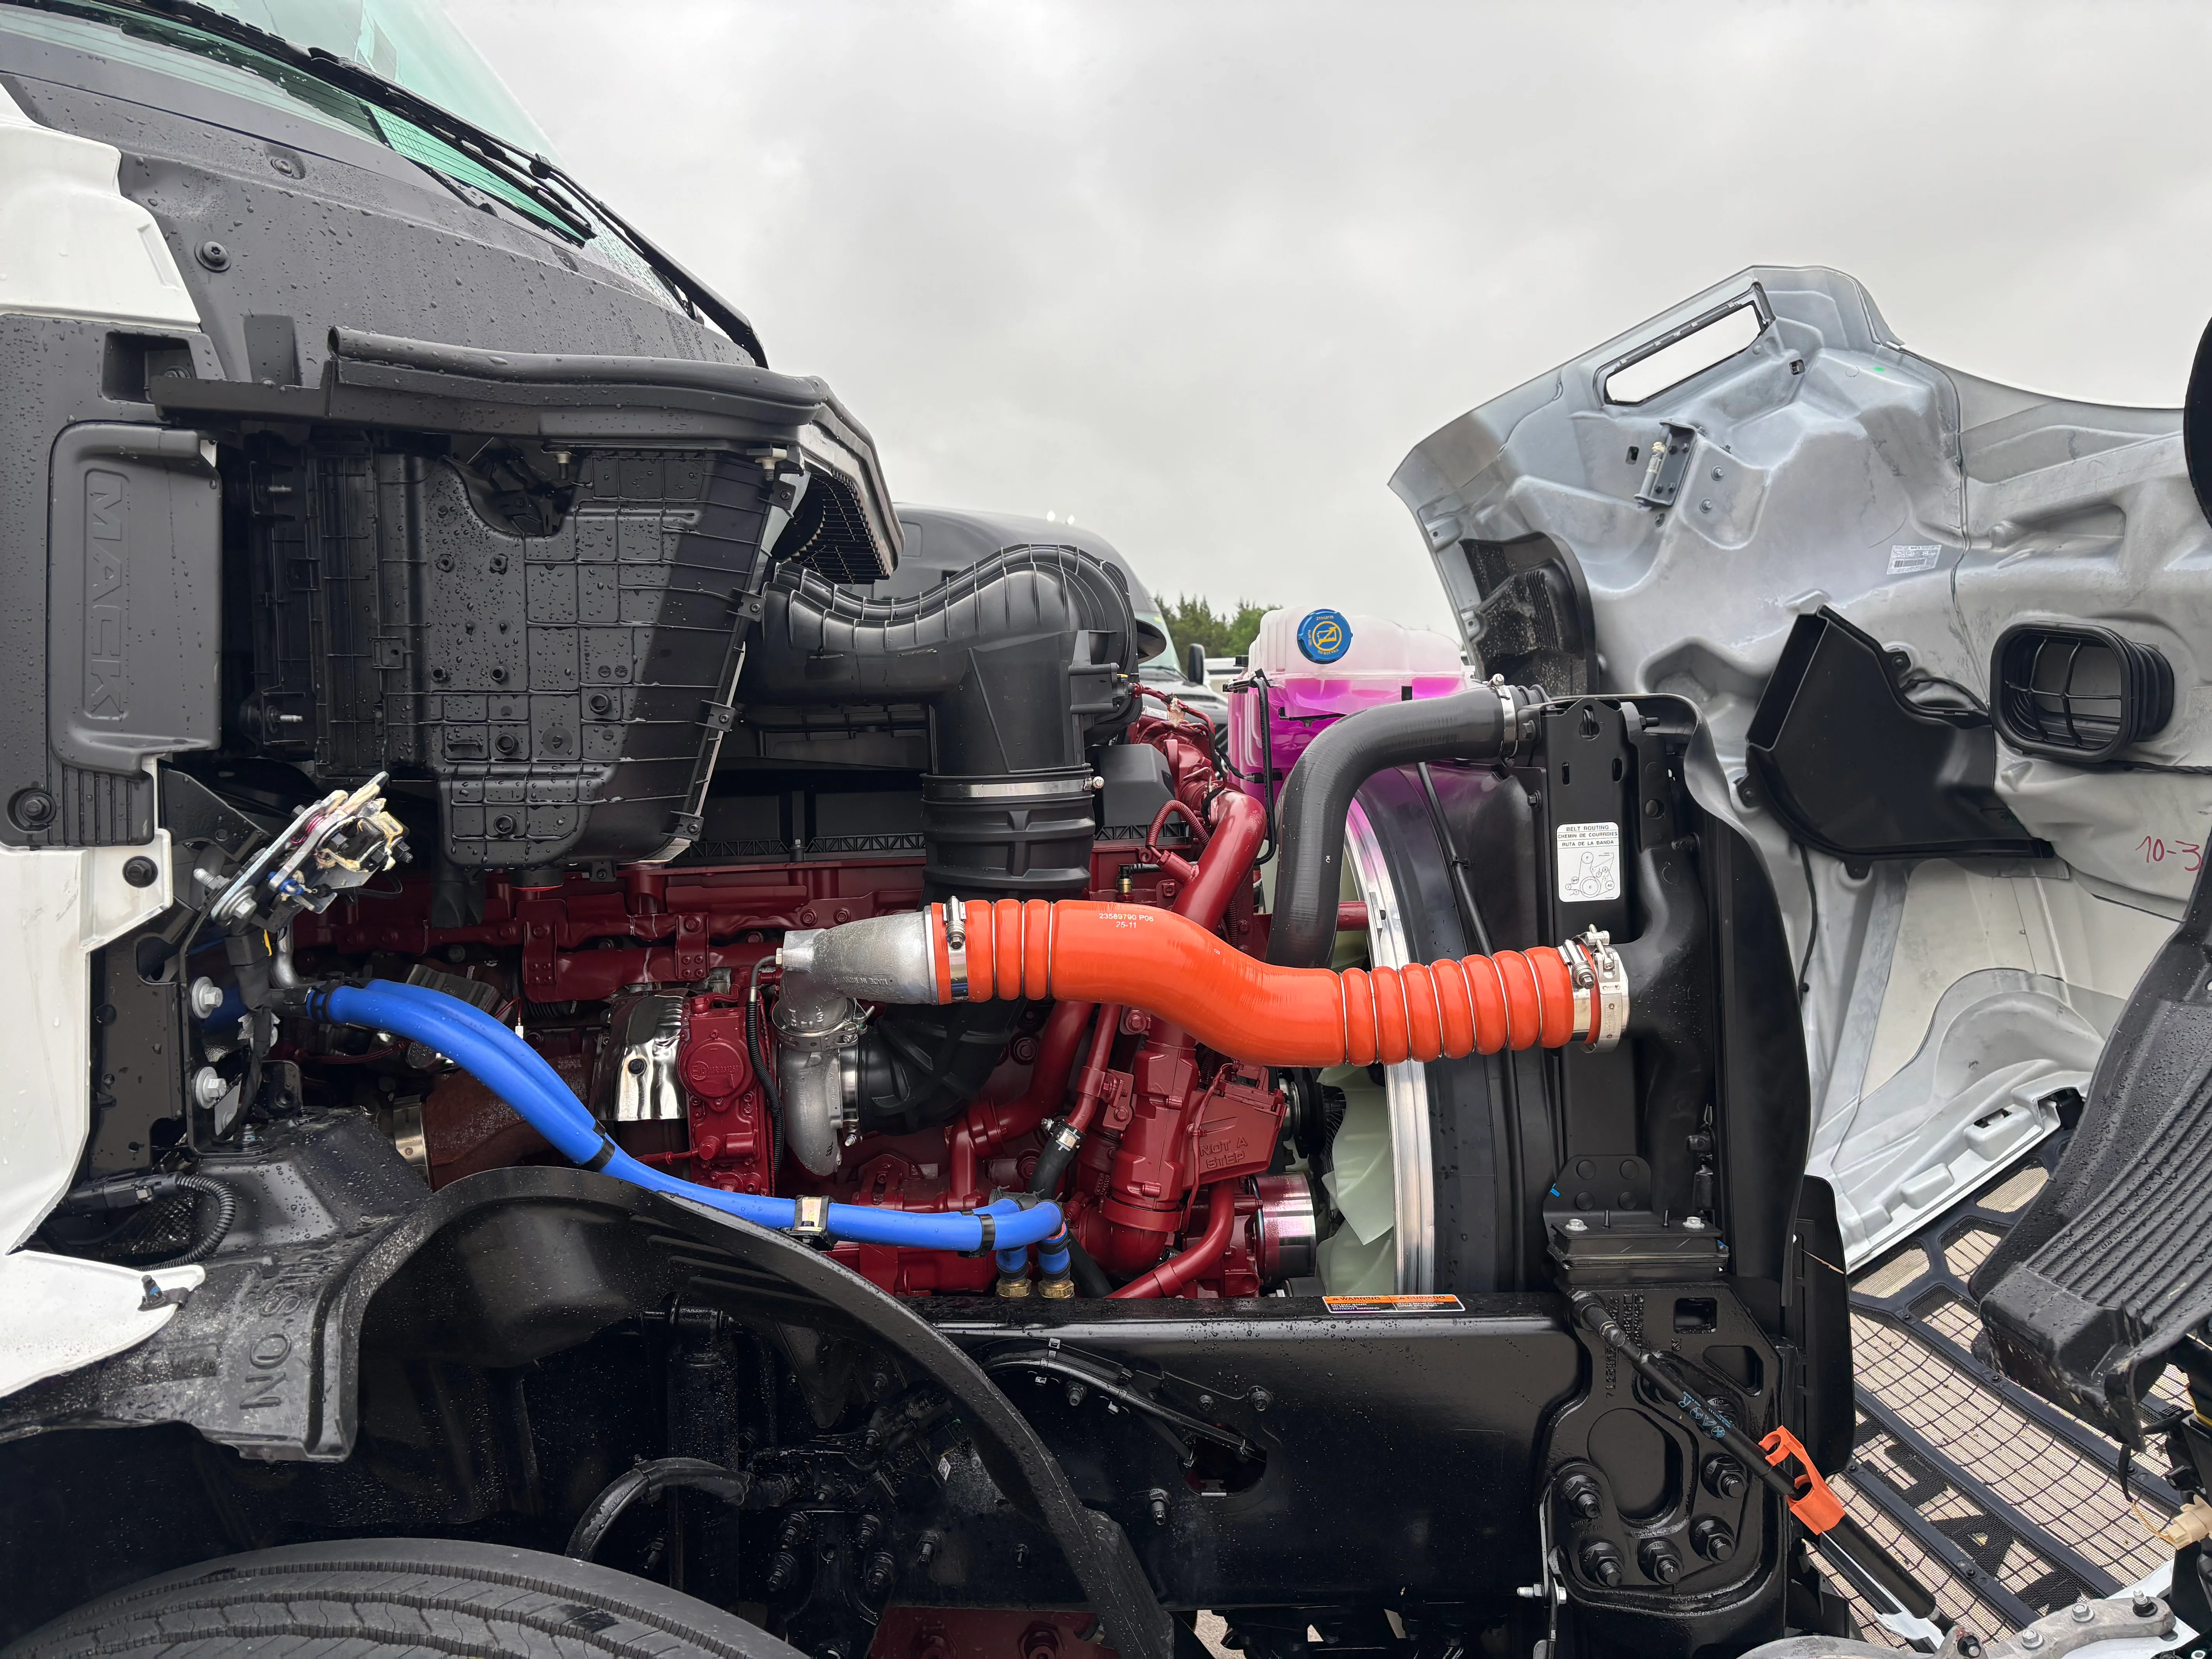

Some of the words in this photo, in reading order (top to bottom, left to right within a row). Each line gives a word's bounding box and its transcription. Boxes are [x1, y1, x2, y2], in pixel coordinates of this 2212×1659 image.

[92, 478, 122, 714] MACK
[1200, 1138, 1231, 1157] NOT
[1237, 1136, 1249, 1148] A
[1206, 1150, 1245, 1170] STEP
[239, 1333, 291, 1410] NO
